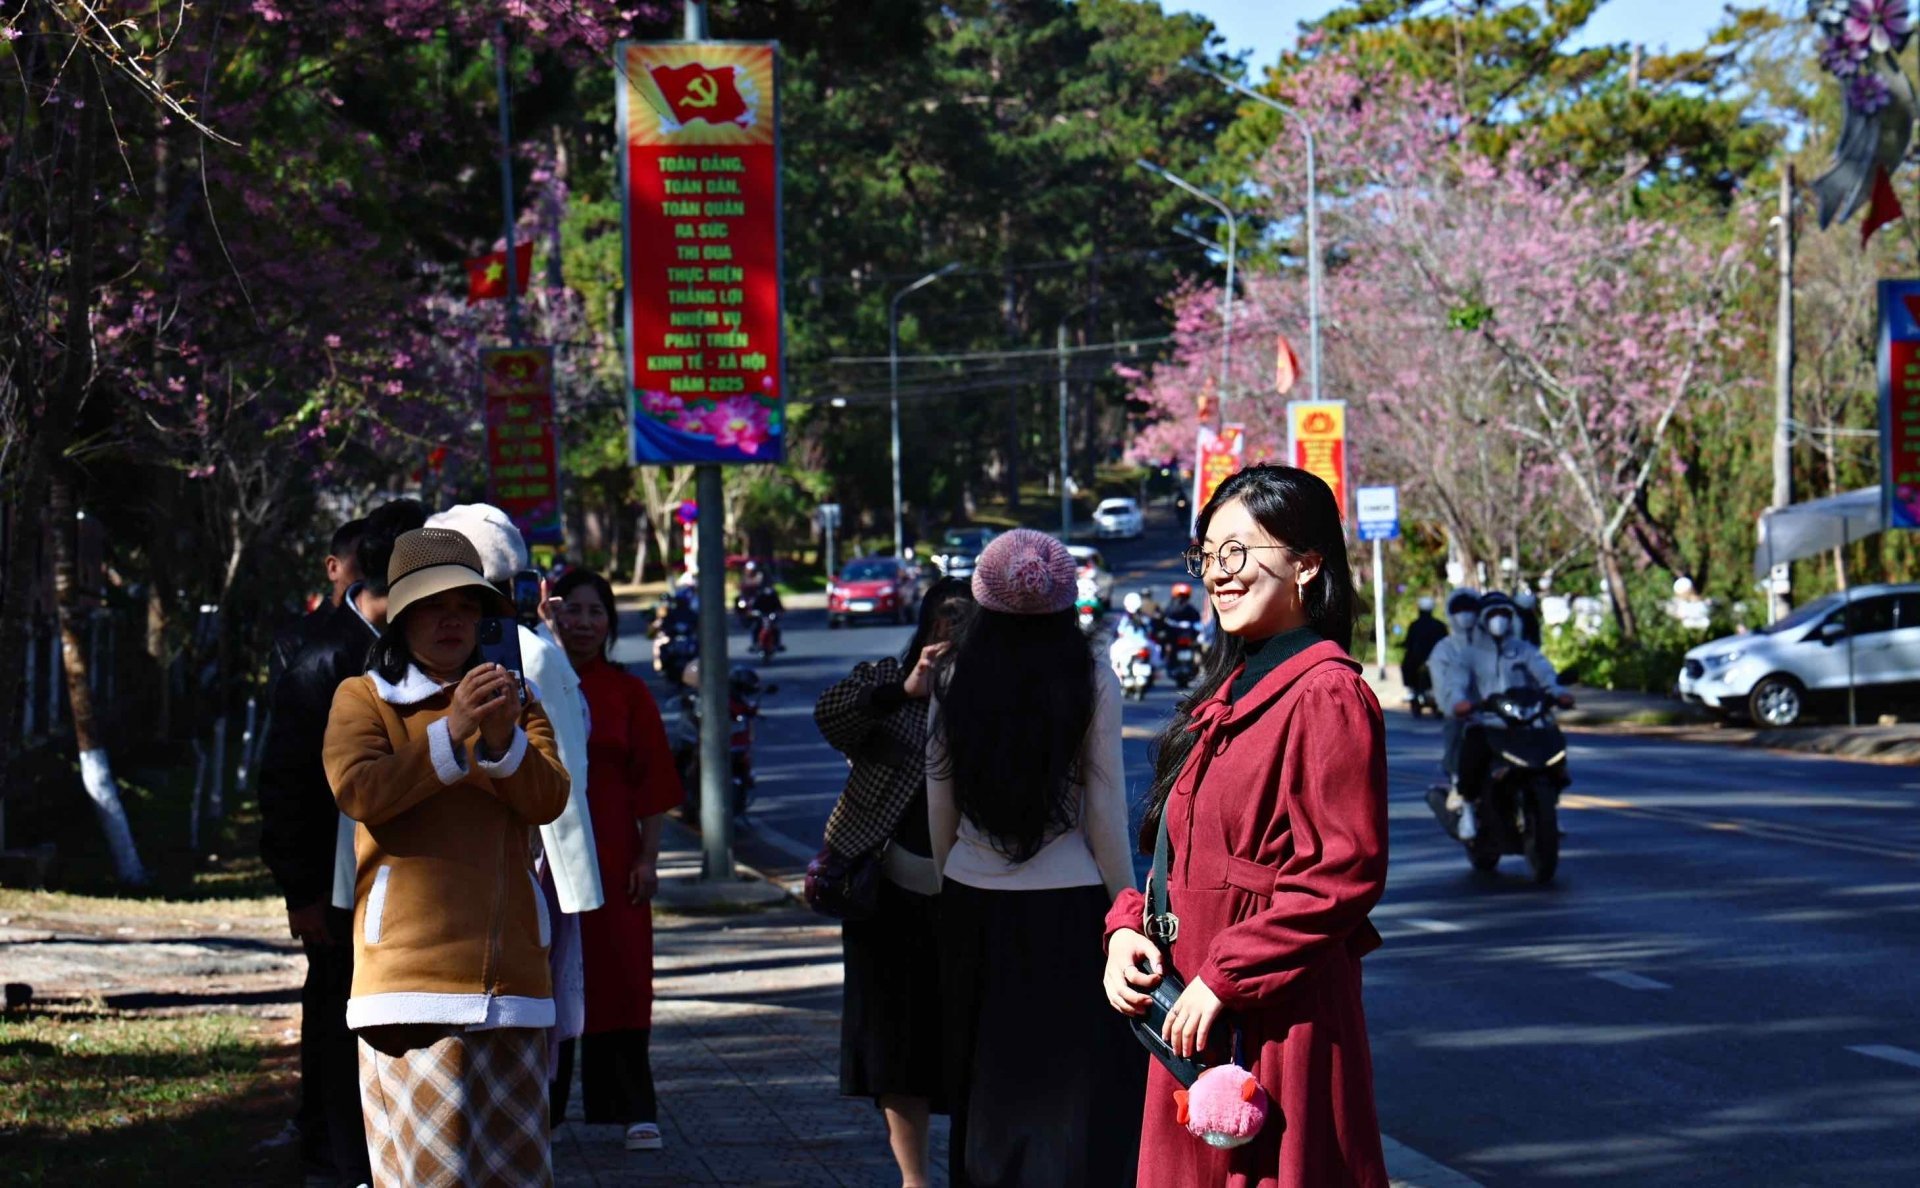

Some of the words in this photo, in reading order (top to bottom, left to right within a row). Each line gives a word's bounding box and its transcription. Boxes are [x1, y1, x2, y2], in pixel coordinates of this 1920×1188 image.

[675, 223, 694, 238] RA
[678, 245, 700, 260] THI
[648, 355, 682, 370] KINH
[687, 351, 703, 370] TẾ
[671, 375, 704, 391] NĂM
[709, 377, 744, 391] 2025
